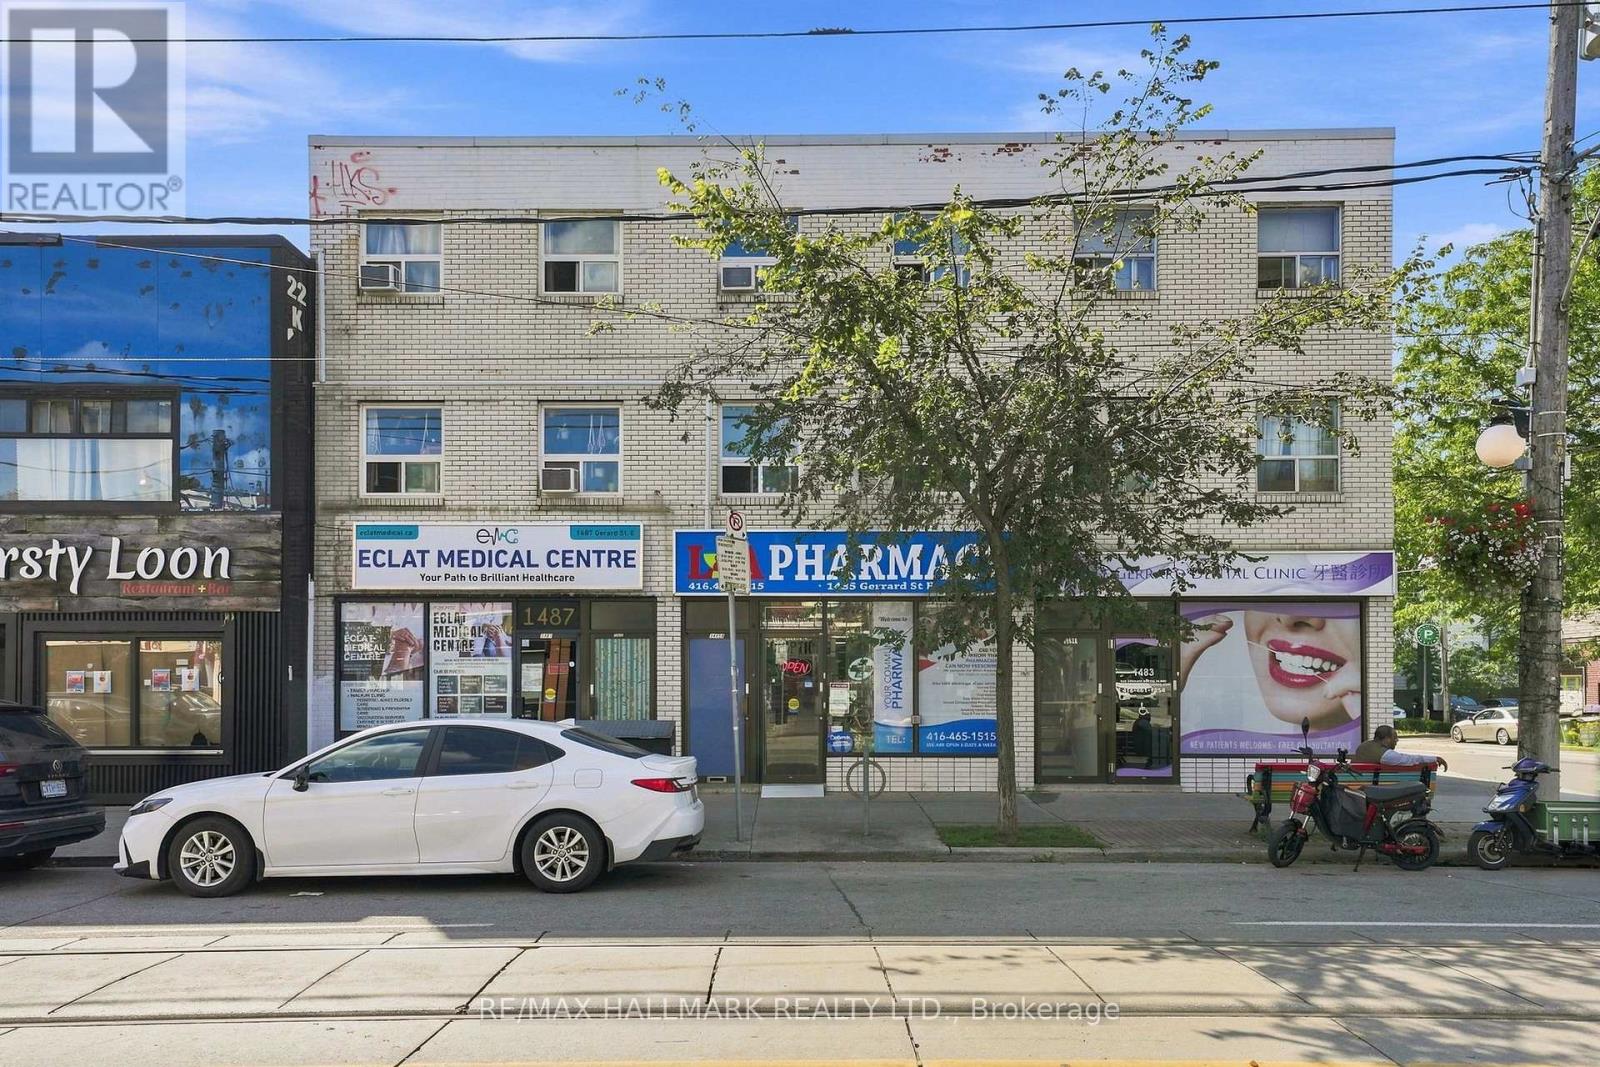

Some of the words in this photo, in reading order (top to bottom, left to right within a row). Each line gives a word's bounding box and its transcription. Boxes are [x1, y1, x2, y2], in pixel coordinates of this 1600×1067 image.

[107, 537, 231, 580] Loon
[358, 549, 430, 568] ECLAT
[437, 549, 539, 568] MEDICAL
[546, 549, 637, 568] CENTRE
[420, 573, 442, 582] Your
[444, 573, 466, 582] Path
[468, 573, 478, 582] to
[480, 573, 520, 582] Brilliant
[522, 573, 575, 582] Healthcare
[910, 582, 924, 590] St
[434, 612, 466, 624] ECLAT
[523, 607, 575, 626] 1487
[434, 626, 484, 638] MEDICAL
[434, 640, 475, 652] CENTRE
[1134, 668, 1154, 677] 1483
[926, 731, 997, 741] 416-465-1515
